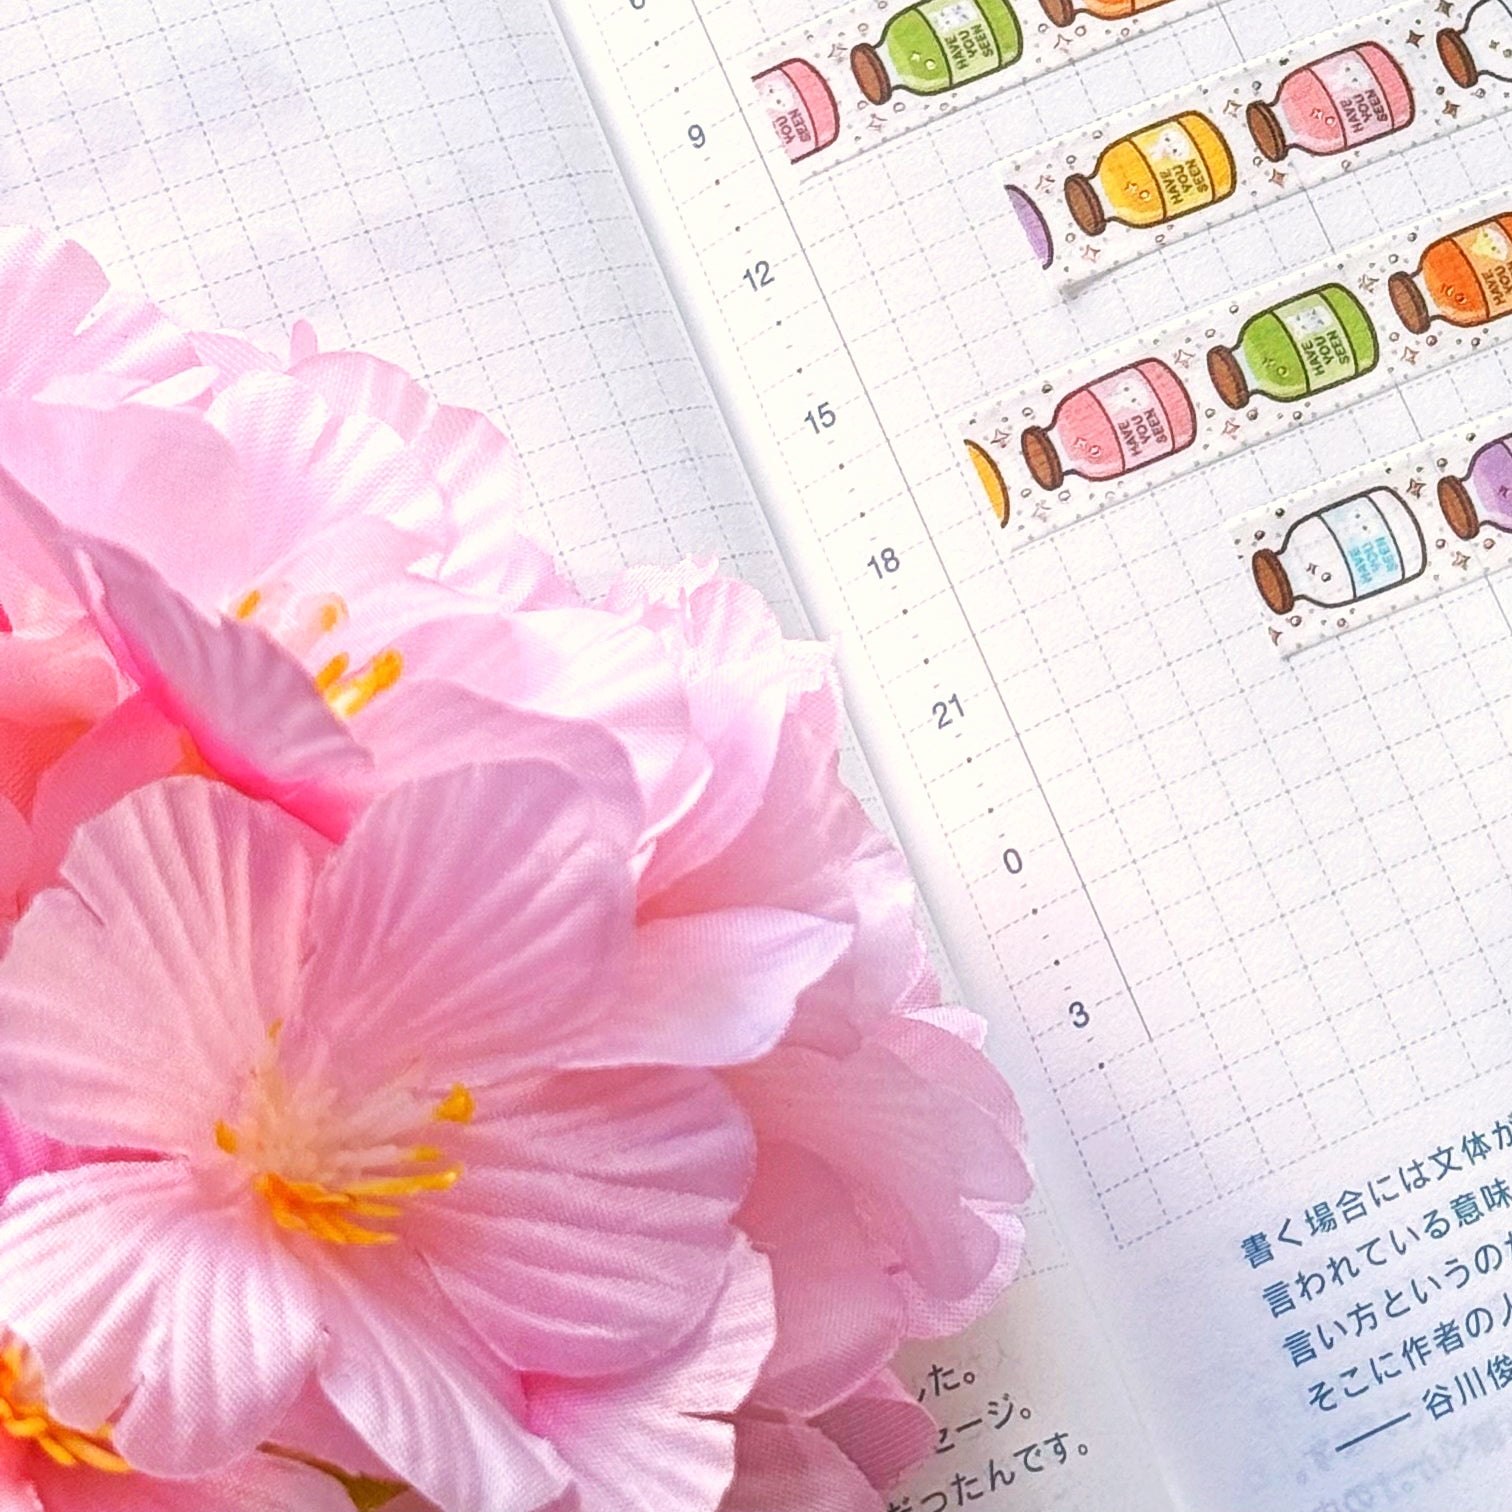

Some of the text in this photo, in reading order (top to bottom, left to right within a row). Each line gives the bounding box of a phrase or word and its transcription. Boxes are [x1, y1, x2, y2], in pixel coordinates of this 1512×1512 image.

[944, 37, 968, 70] HAVE
[958, 30, 975, 57] YOU
[1340, 100, 1364, 133] HAVE
[1352, 94, 1371, 123] YOU
[688, 124, 707, 149] 9
[1159, 169, 1183, 205] HAVE
[1172, 164, 1191, 193] YOU
[743, 260, 776, 292] 12
[1481, 272, 1506, 306] HAVE
[1301, 340, 1325, 376] HAVE
[1313, 336, 1334, 364] YOU
[804, 402, 838, 435] 15
[1131, 416, 1150, 444] YOU
[1118, 421, 1142, 456] HAVE
[867, 547, 900, 580] 18
[931, 693, 966, 730] 21
[1002, 848, 1024, 875] 0
[1068, 1001, 1091, 1028] 3
